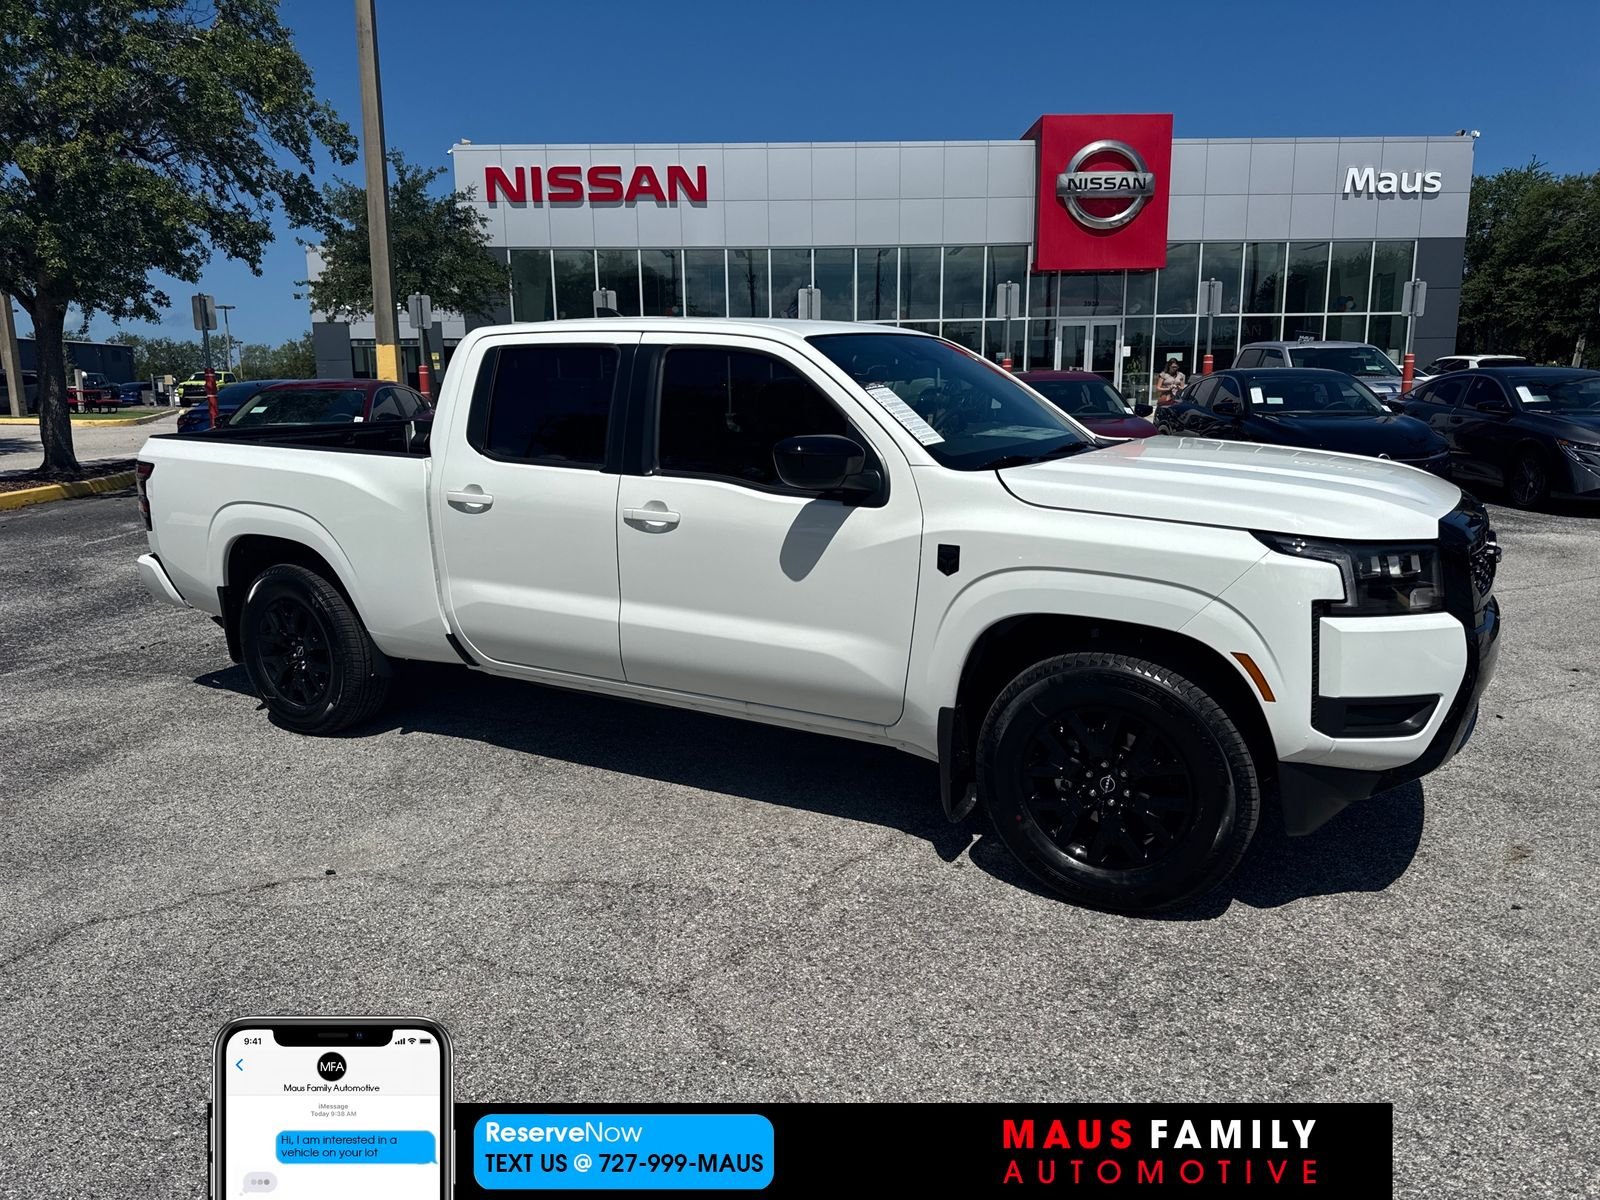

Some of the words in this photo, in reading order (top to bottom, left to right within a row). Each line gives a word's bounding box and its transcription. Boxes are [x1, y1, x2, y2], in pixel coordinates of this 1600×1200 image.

[485, 165, 707, 203] NISSAN
[1067, 176, 1147, 191] NISSAN
[1344, 167, 1442, 194] Maus
